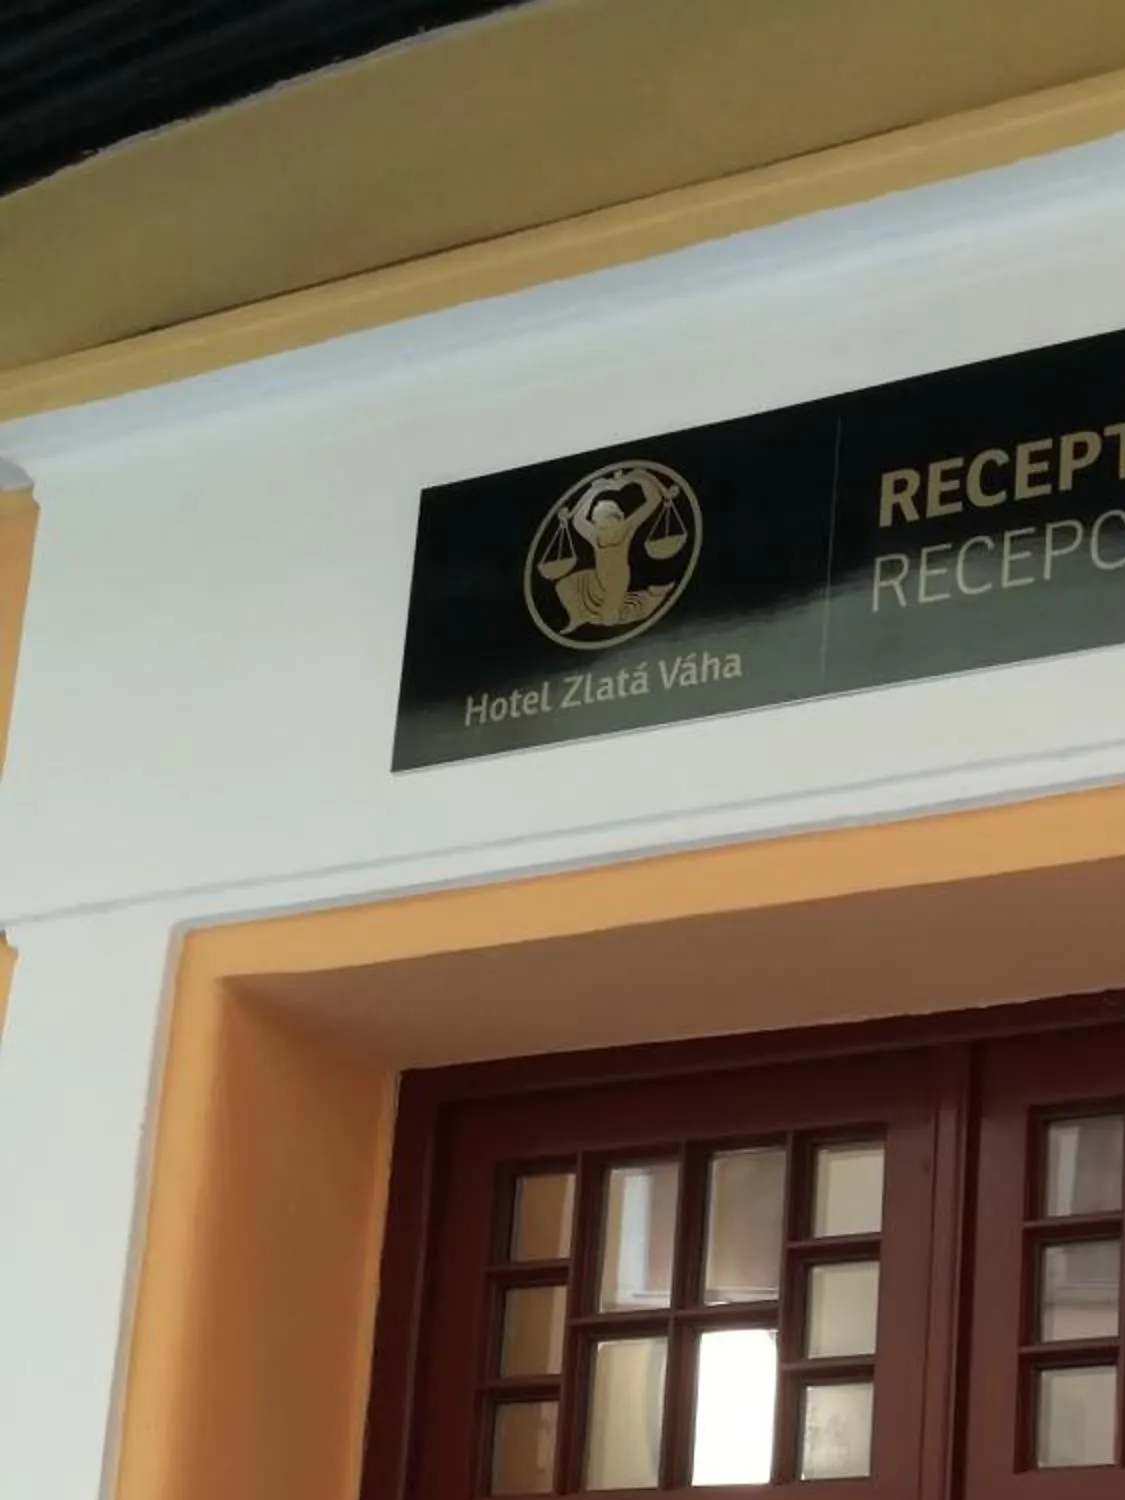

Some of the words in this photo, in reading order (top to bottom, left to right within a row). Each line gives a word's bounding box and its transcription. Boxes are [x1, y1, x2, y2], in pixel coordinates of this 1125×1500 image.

[464, 683, 552, 728] Hotel
[561, 662, 651, 709] Zlatá
[659, 650, 744, 692] Váha
